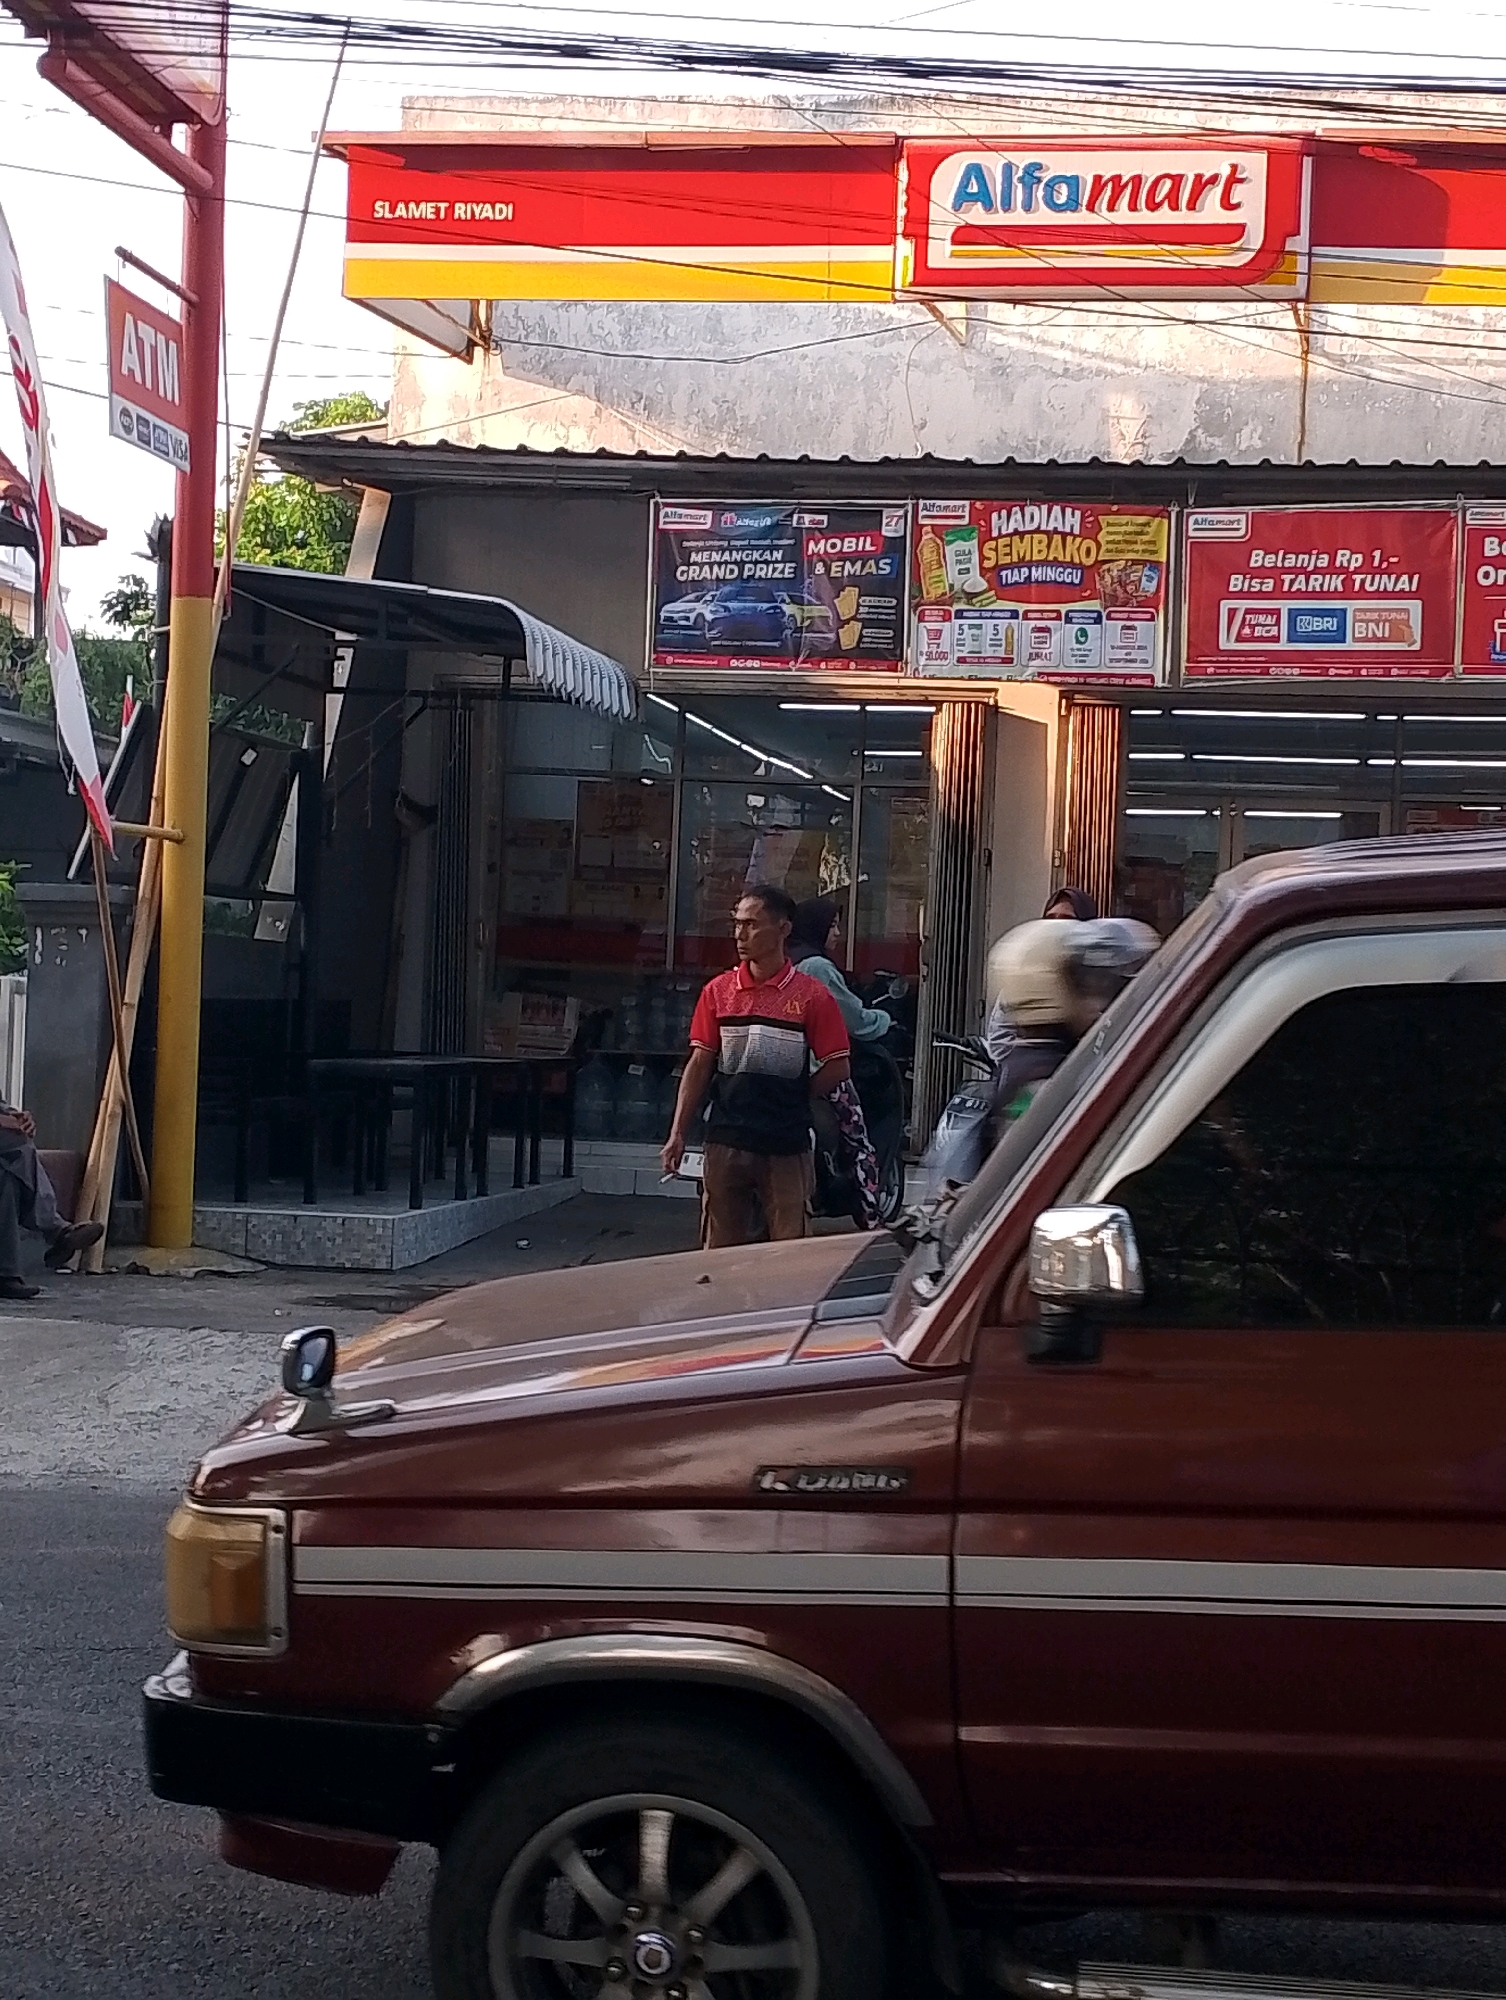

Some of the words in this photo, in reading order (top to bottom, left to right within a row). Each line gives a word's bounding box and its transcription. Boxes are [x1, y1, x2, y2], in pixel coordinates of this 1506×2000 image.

[950, 160, 1248, 213] Alfamart
[373, 200, 449, 220] SLAMET
[453, 202, 514, 220] RIYADI
[121, 311, 180, 407] ATM
[920, 502, 967, 513] Alfamart
[990, 504, 1082, 538] HADIAH
[1192, 516, 1242, 528] Alfamart
[807, 535, 878, 556] MOBIL
[982, 533, 1098, 569] SEMBAKO
[689, 549, 783, 563] MENANGKAN
[1249, 549, 1330, 571] Belanja
[1334, 550, 1364, 572] Rp
[676, 564, 739, 581] GRAND
[742, 563, 798, 580] PRIZE
[814, 561, 825, 575] &
[829, 558, 892, 578] EMAS
[1000, 567, 1028, 585] TIAP
[1031, 566, 1083, 585] MINGGU
[1228, 574, 1275, 592] Bisa
[1280, 574, 1346, 592] TARIK
[1352, 574, 1419, 592] TUNAI
[1244, 613, 1277, 625] TUNAI
[1312, 616, 1338, 631] BRI
[1354, 611, 1380, 619] TARIK
[1380, 611, 1409, 619] TUNAI
[957, 623, 965, 636] 5
[992, 623, 1000, 637] 5
[1354, 622, 1390, 638] BNI
